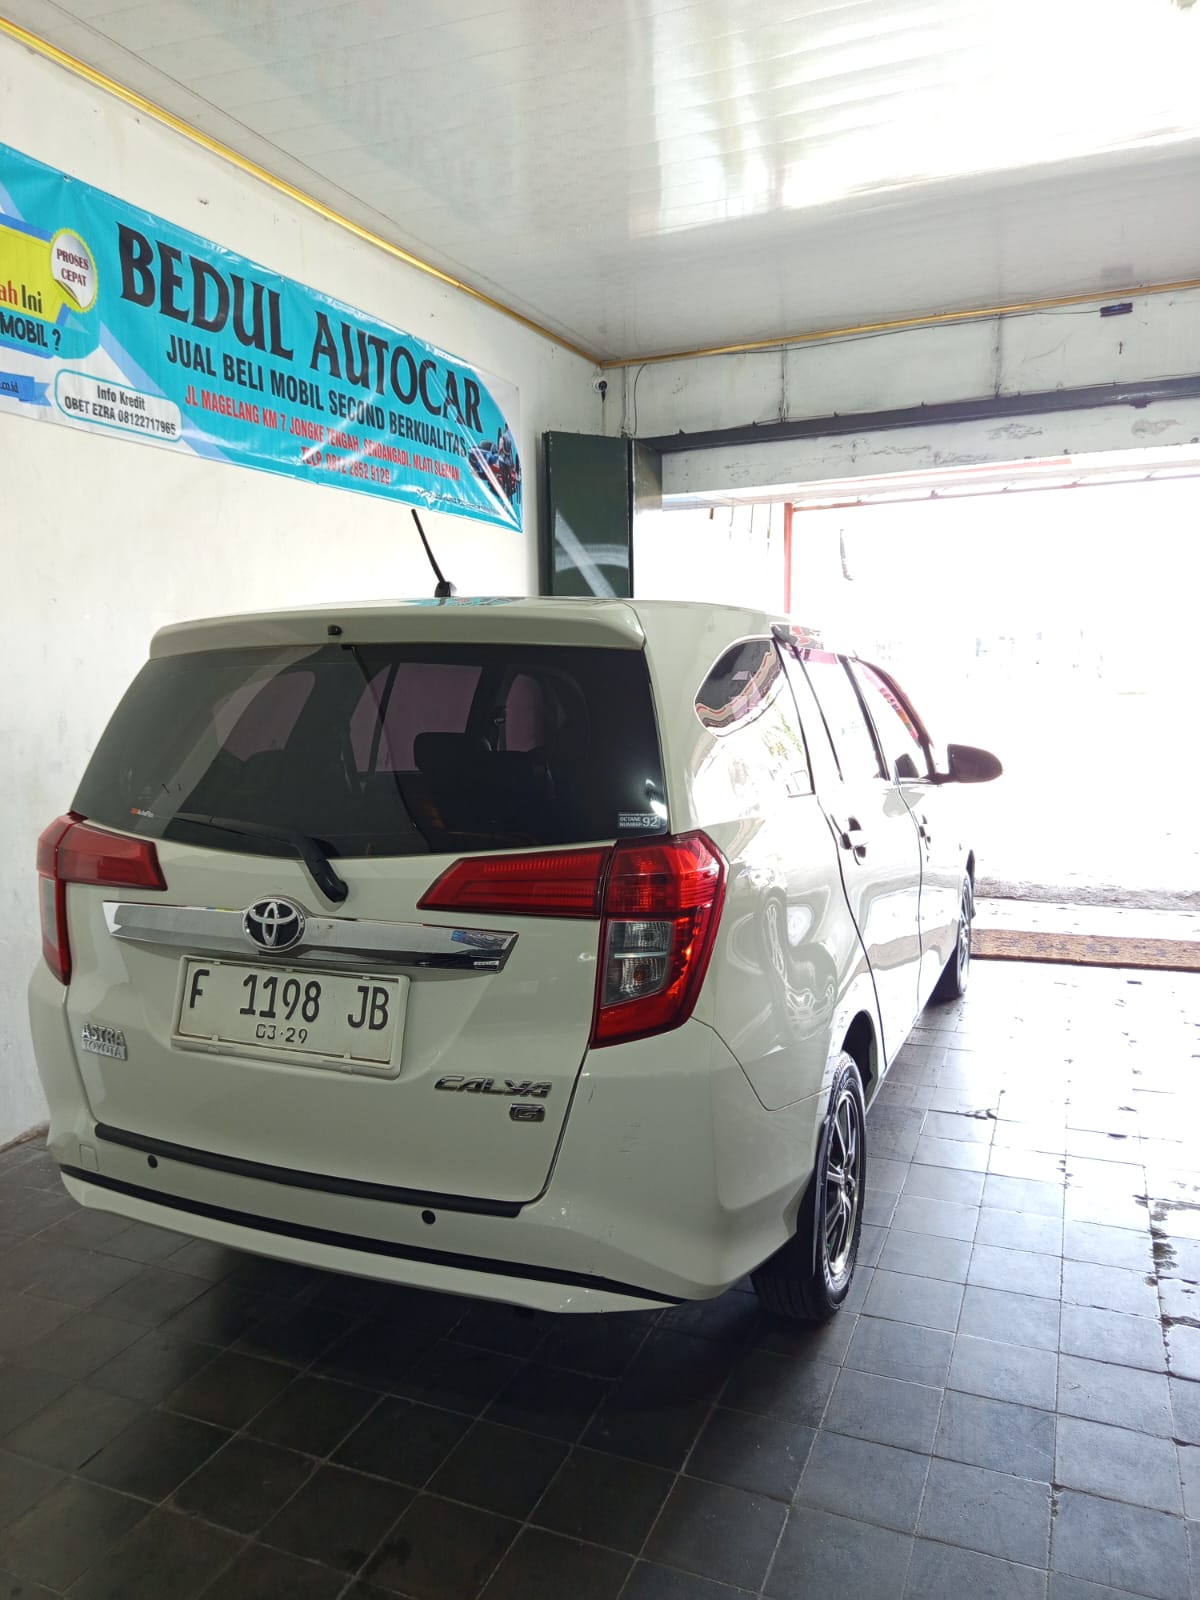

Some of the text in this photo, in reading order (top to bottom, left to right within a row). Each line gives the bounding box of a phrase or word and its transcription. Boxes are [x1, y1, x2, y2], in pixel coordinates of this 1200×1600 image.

[57, 248, 89, 270] PROSES
[61, 268, 87, 287] CEPAT
[21, 284, 42, 313] Ini
[0, 312, 48, 348] MOBIL
[117, 222, 483, 433] BEDUL AUTOCAR
[97, 385, 145, 411] Info Kredit
[167, 335, 467, 457] JUAL BELI MOBIL SECOND BERKUALITAS
[65, 396, 177, 436] OBET EZRA 08122717965
[185, 385, 198, 407] JL
[201, 389, 259, 424] MAGELANG
[262, 408, 278, 430] KM
[280, 414, 287, 432] 7
[290, 417, 324, 442] JONGKE
[413, 454, 433, 473] MLATI
[434, 463, 460, 481] SLEMAN
[350, 461, 369, 480] 2852
[642, 816, 658, 828] 92
[189, 969, 389, 1031] F 1198 JB
[82, 1023, 125, 1047] ASTRA
[82, 1039, 126, 1060] TOYOTA
[434, 1075, 552, 1098] CALYA
